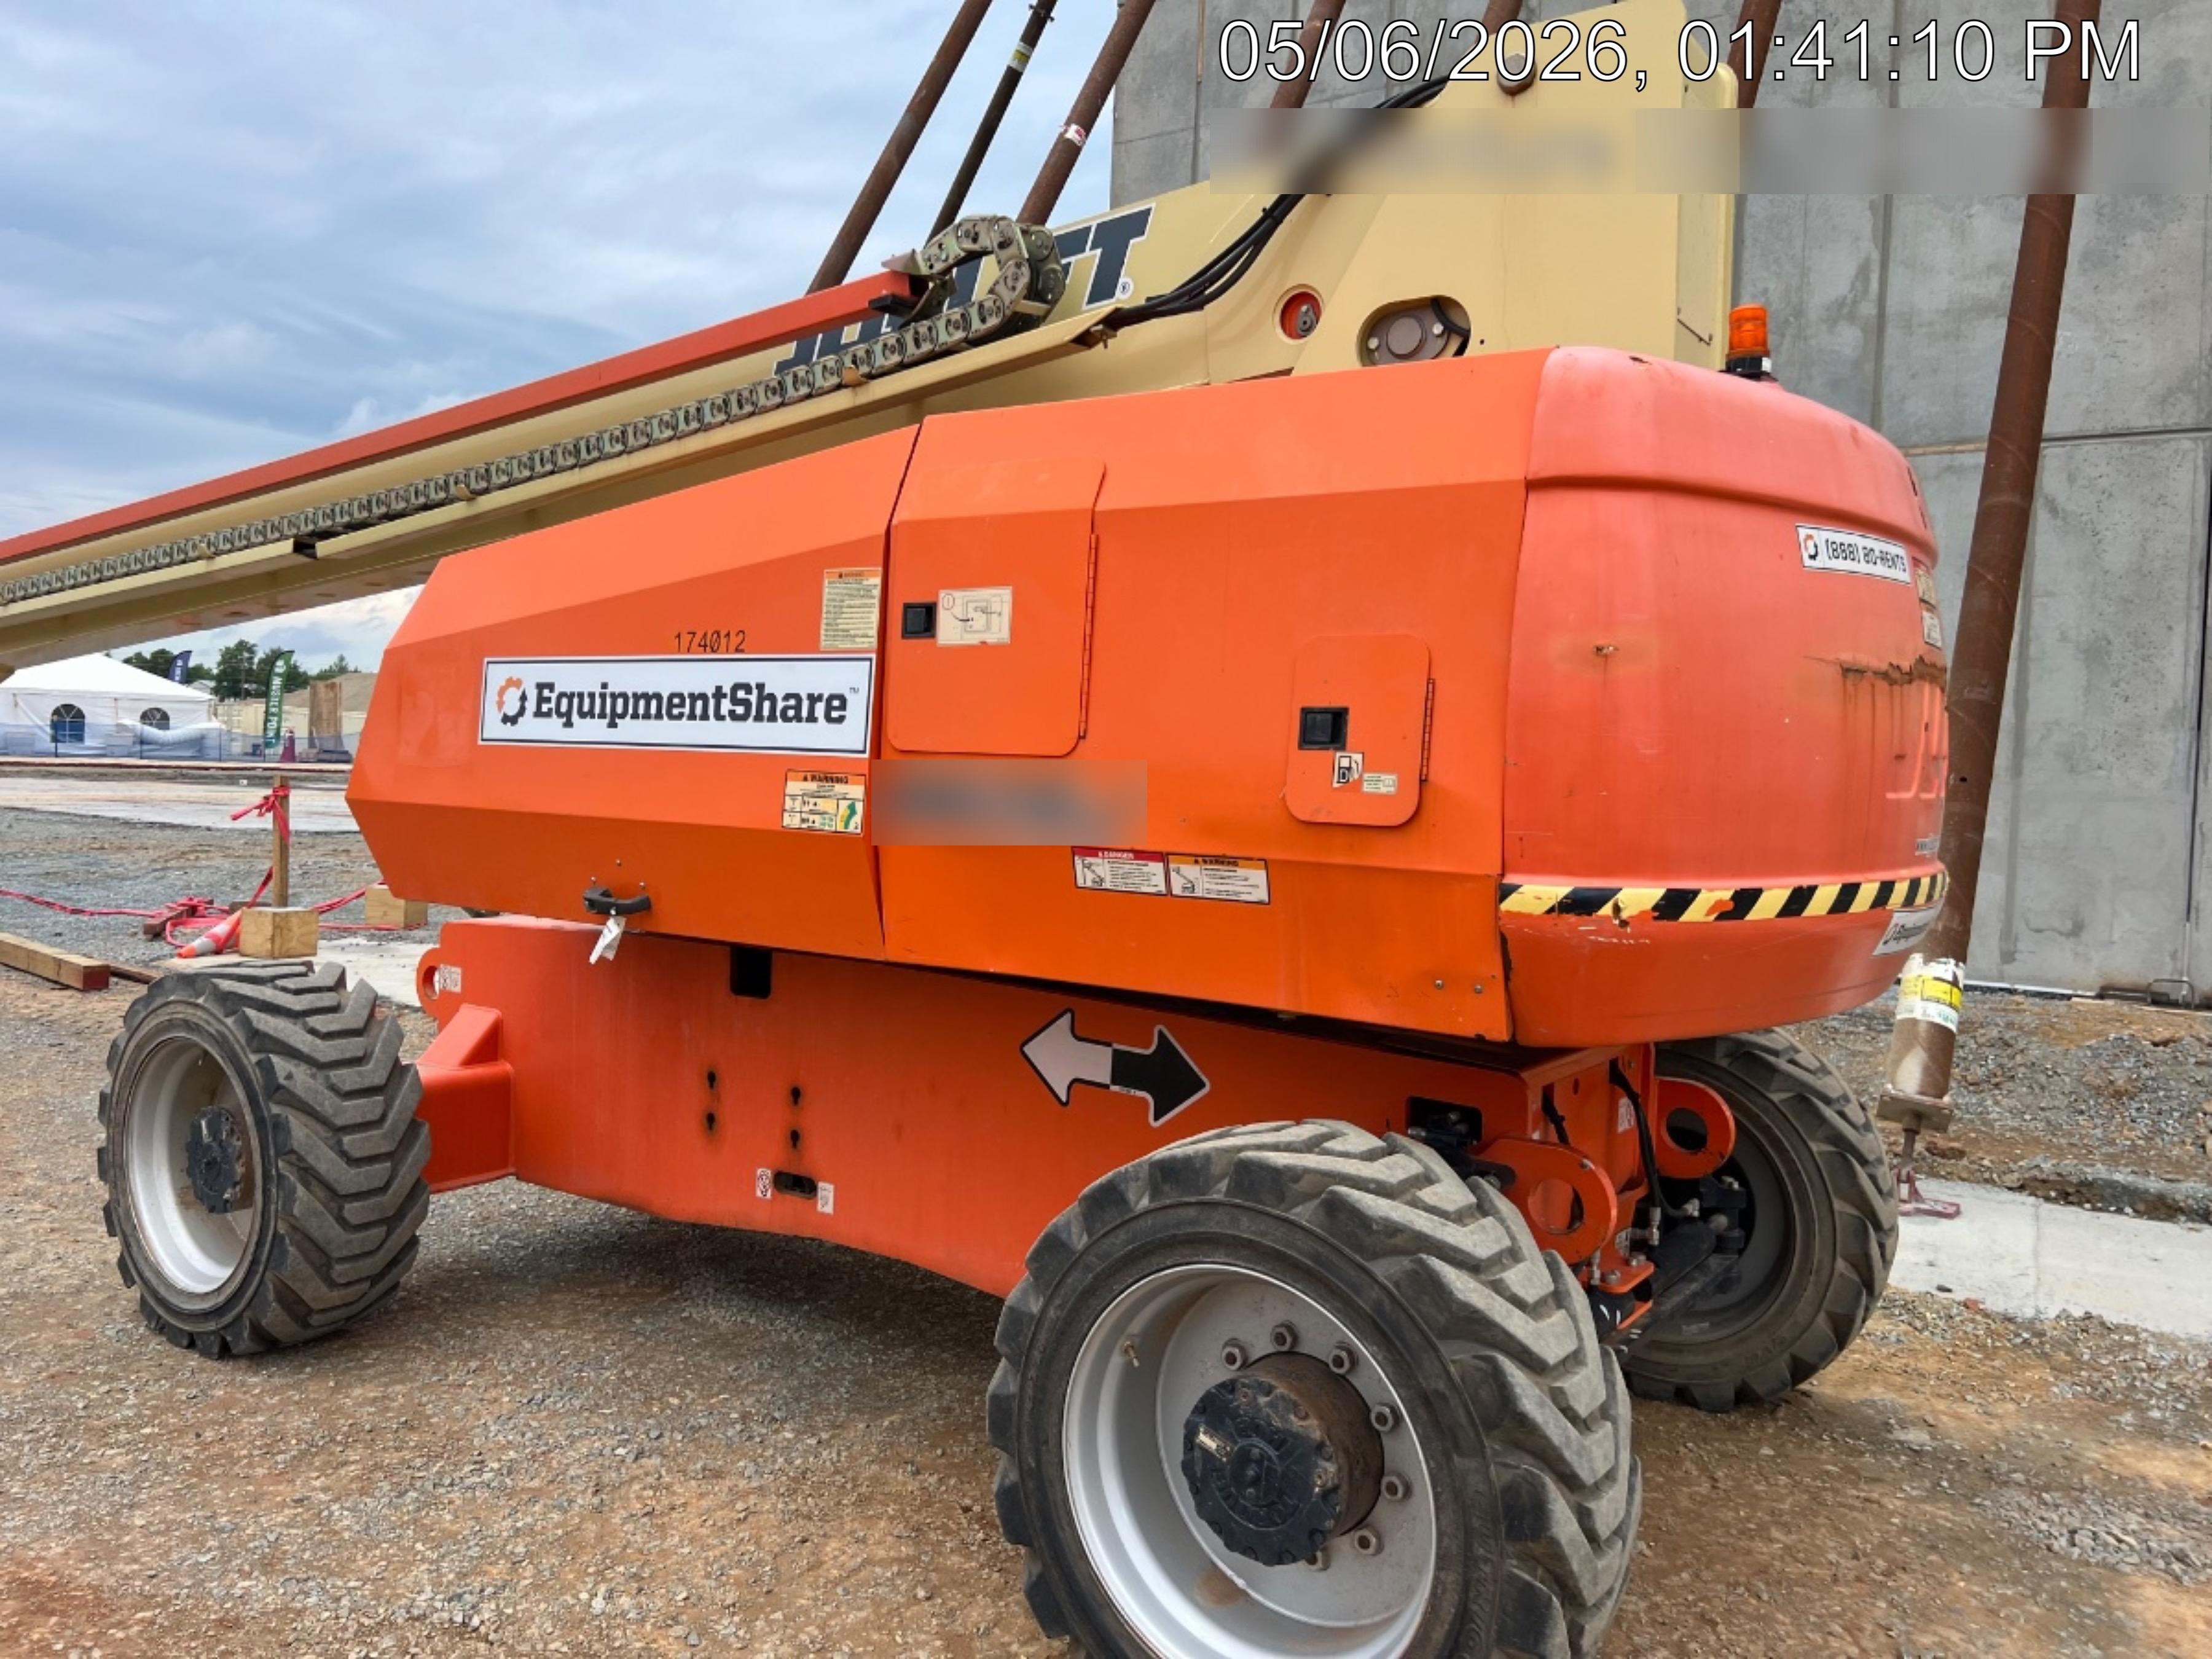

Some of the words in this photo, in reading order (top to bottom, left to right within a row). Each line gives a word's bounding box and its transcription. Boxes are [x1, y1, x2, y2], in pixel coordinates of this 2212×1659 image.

[1825, 538, 1861, 565] (888)
[674, 629, 745, 653] 174012
[533, 682, 847, 728] EquipmentShare
